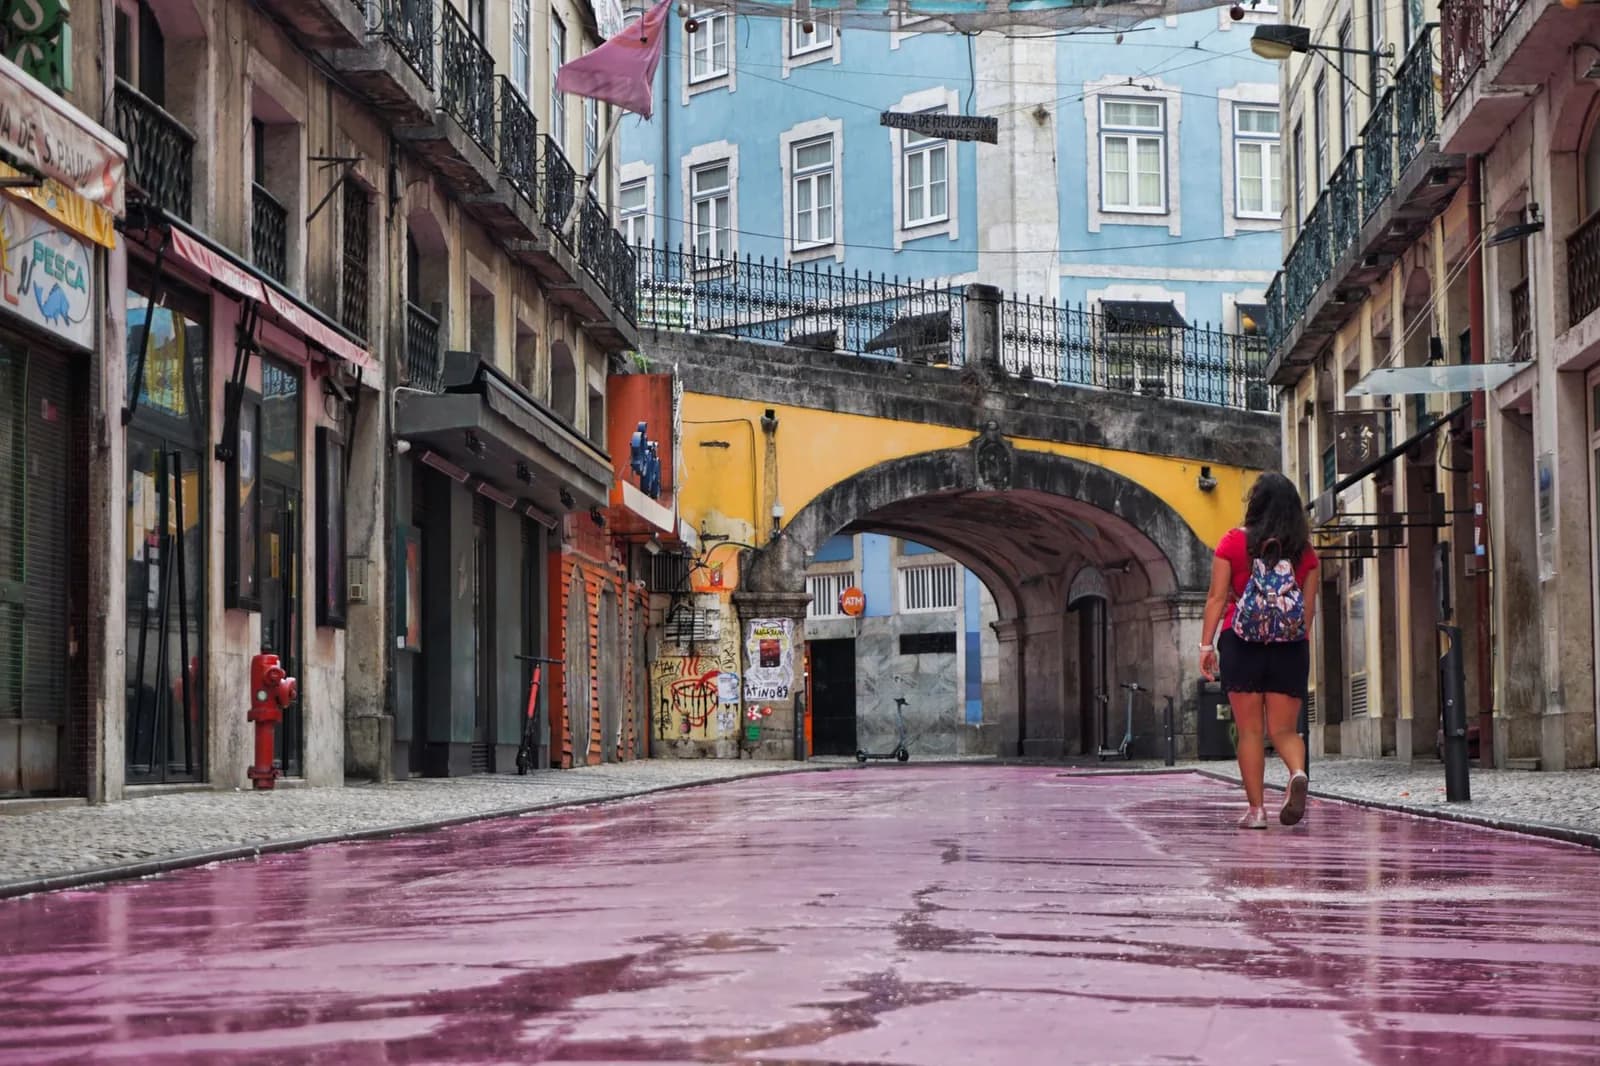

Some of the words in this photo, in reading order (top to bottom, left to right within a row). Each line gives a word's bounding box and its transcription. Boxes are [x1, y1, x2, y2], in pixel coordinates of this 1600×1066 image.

[17, 118, 36, 156] DE
[33, 239, 87, 294] PESCA
[845, 596, 863, 606] ATM
